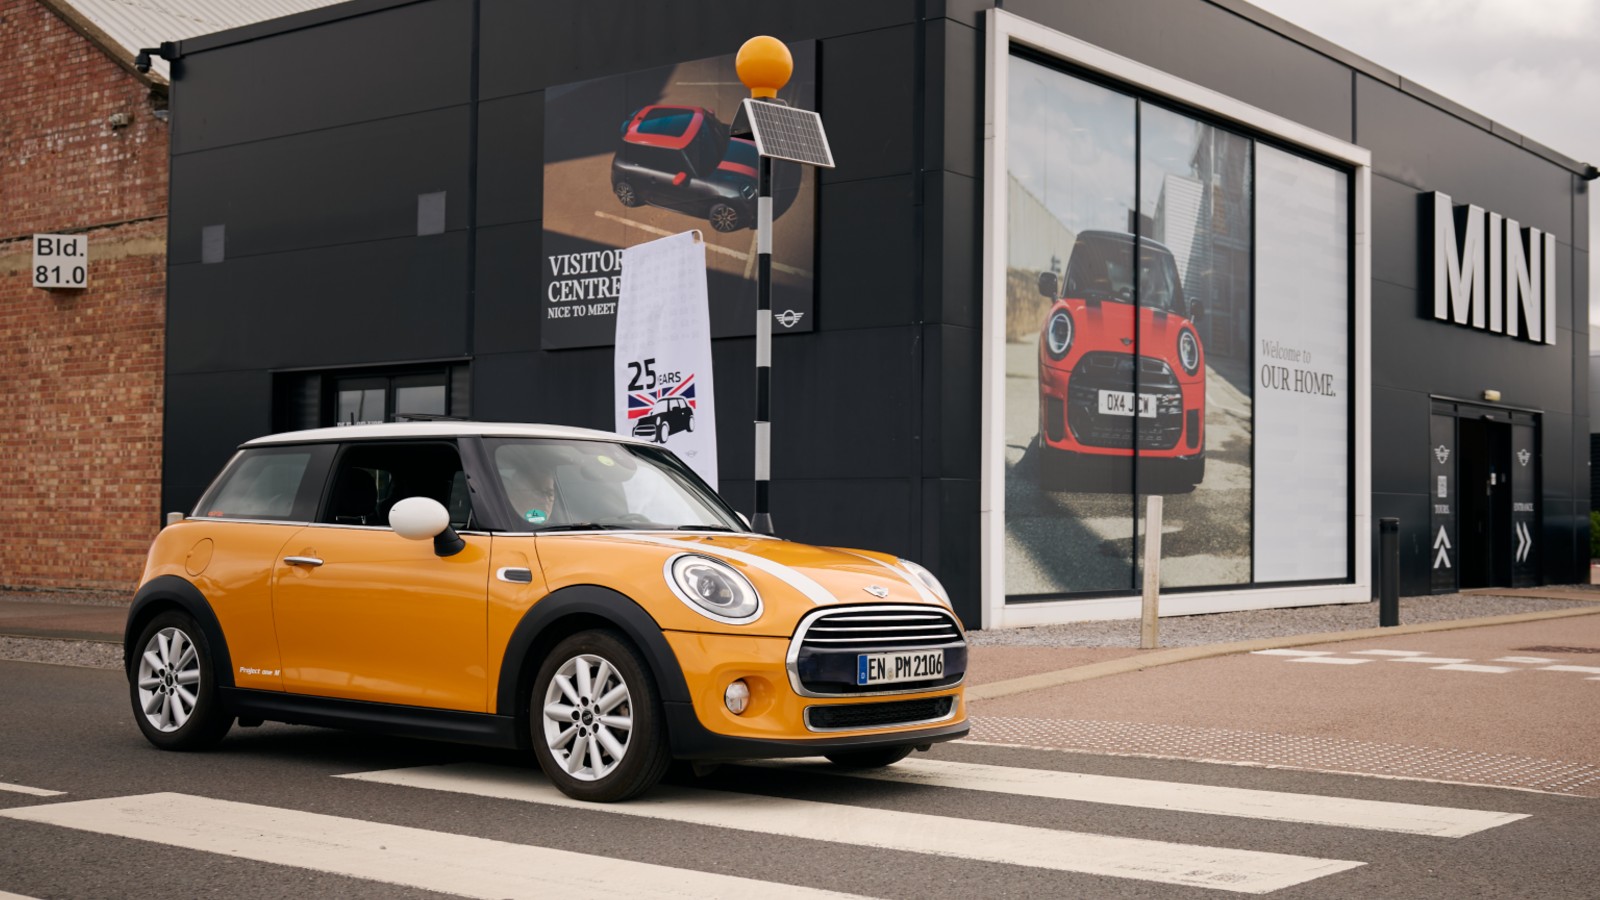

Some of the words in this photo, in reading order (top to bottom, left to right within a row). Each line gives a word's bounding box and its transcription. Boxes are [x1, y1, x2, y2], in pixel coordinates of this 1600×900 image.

[37, 237, 84, 257] Bld.
[35, 265, 85, 284] 81.0
[548, 249, 623, 276] VISITOR
[1434, 190, 1556, 345] MINI
[548, 276, 621, 302] CENTRE
[547, 306, 571, 319] NICE
[572, 305, 586, 317] TO
[587, 302, 616, 316] MEET
[1262, 339, 1300, 363] Welcome
[1302, 349, 1311, 364] to
[627, 357, 656, 392] 25
[659, 371, 682, 385] EARS
[1261, 364, 1291, 391] OUR
[1294, 369, 1336, 397] HOME.
[868, 657, 885, 680] EN
[895, 656, 911, 678] PM
[914, 653, 943, 676] 2106
